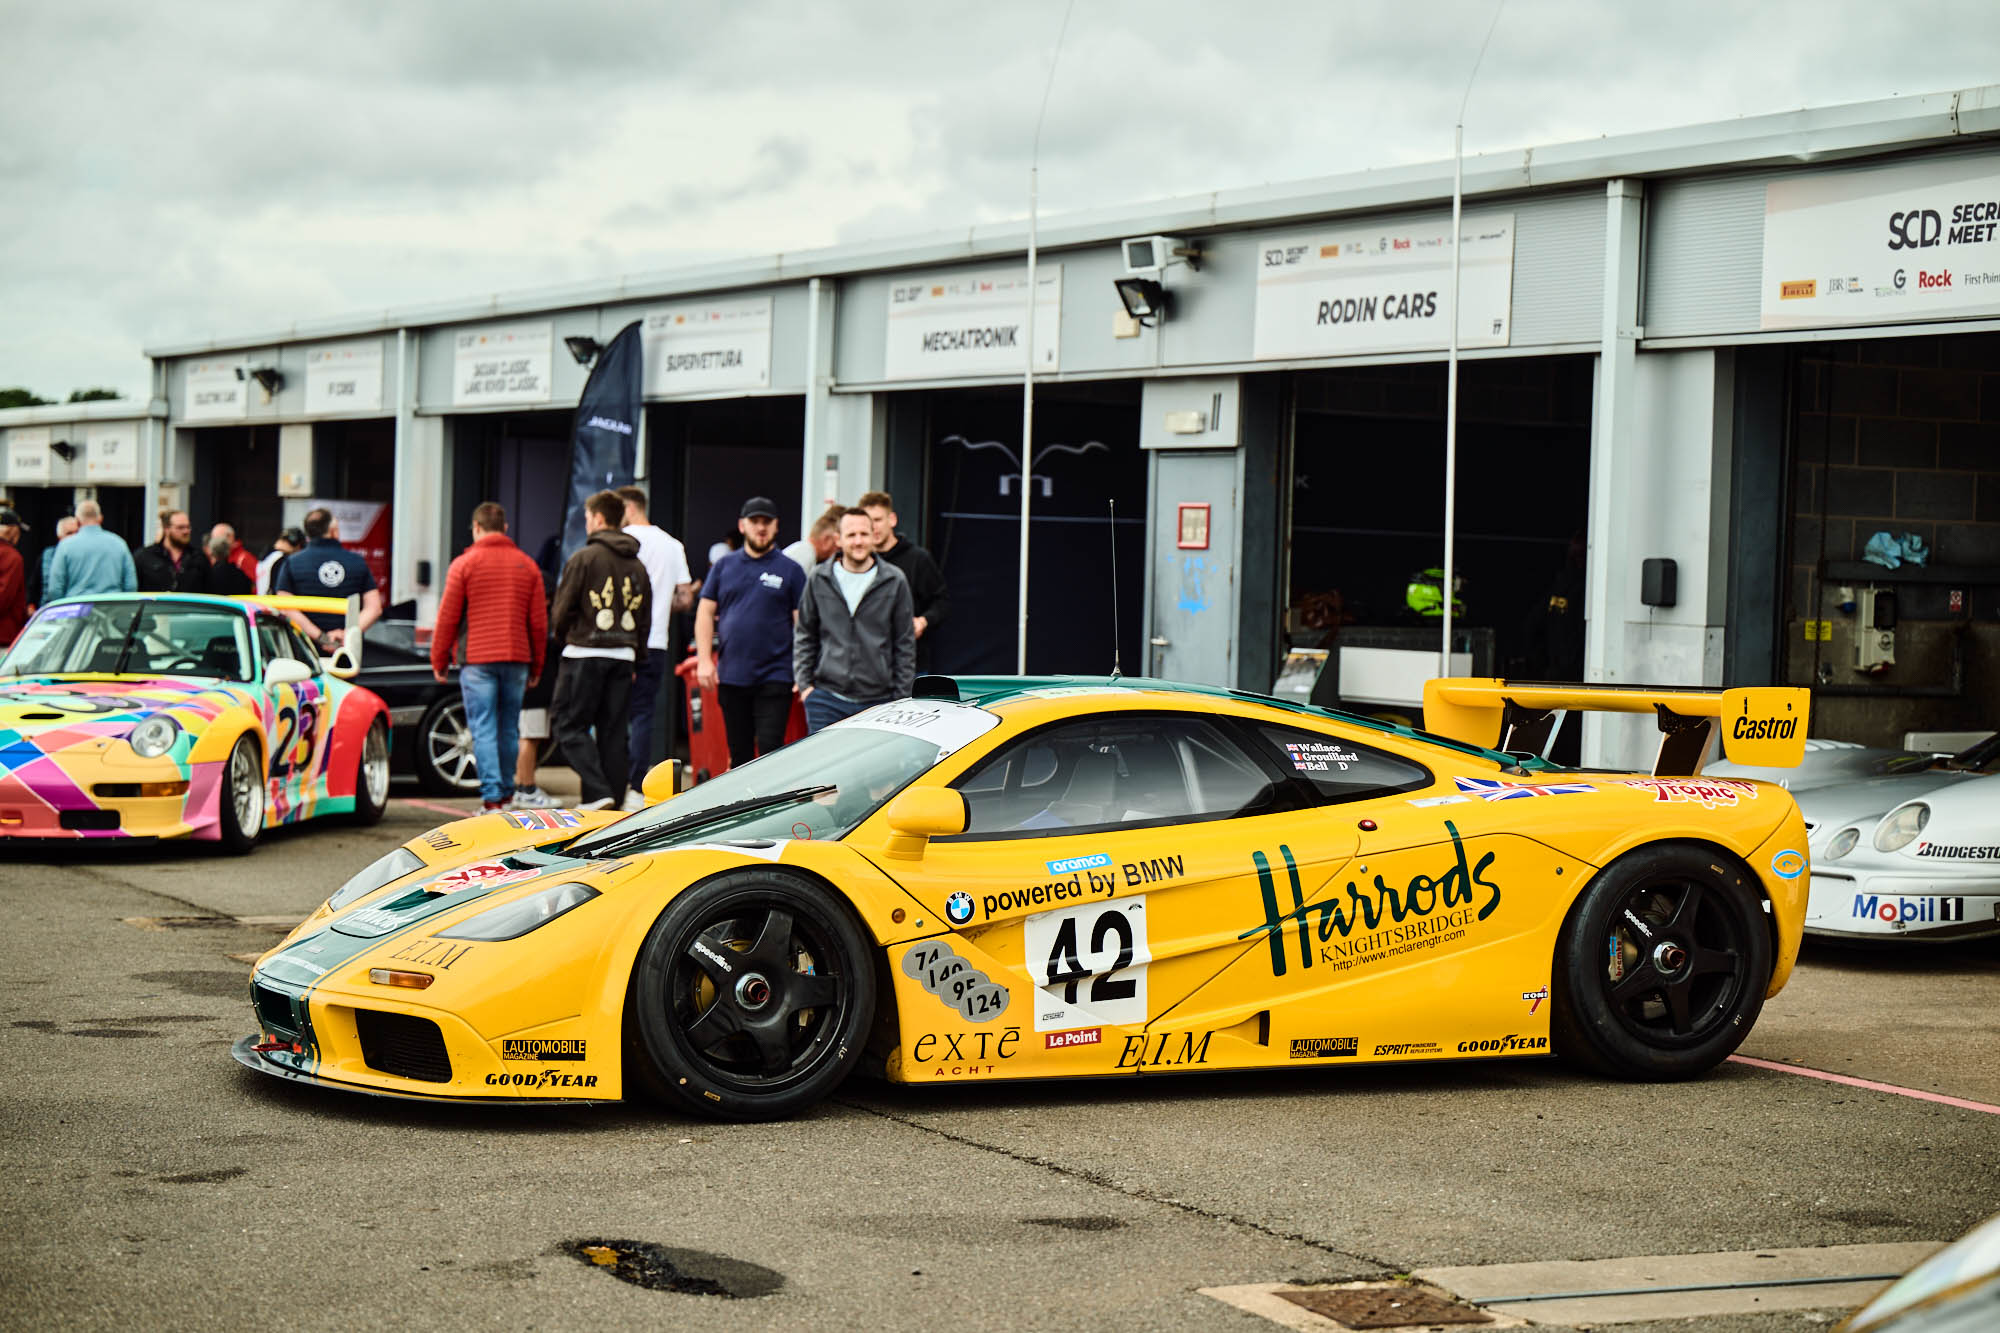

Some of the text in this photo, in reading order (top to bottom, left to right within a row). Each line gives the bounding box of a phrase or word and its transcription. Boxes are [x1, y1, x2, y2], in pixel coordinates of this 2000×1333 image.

[1952, 202, 2000, 223] SECR
[1948, 223, 1997, 245] MEET
[1918, 269, 1952, 288] Rock
[1964, 273, 1981, 286] First
[1317, 291, 1438, 325] RODIN CARS
[922, 325, 1019, 353] MECHATRONIK
[1733, 716, 1798, 740] Castrol
[269, 704, 319, 778] 23
[1298, 743, 1341, 753] Wallace
[1303, 752, 1359, 762] Grouillard
[1306, 761, 1348, 771] Bell D
[1052, 855, 1106, 873] aramco
[983, 855, 1185, 920] powered by BMW
[1238, 820, 1501, 977] Harrods
[1852, 894, 1956, 923] Mobil 1
[1320, 908, 1475, 964] KNIGHTSBRIDGE
[388, 940, 475, 971] E.I.M
[694, 941, 733, 973] speedline
[915, 948, 939, 971] 74
[1046, 910, 1137, 1005] 42
[1333, 928, 1466, 972] http://www.mclarengtr.com
[966, 990, 1001, 1016] 124
[1050, 1029, 1098, 1047] Le Point
[1114, 1030, 1217, 1069] E.I.M
[503, 1052, 539, 1061] MAGAZINE
[1290, 1050, 1320, 1058] MAGAZINE
[1374, 1044, 1412, 1056] ESPRIT
[935, 1065, 996, 1076] ACHT
